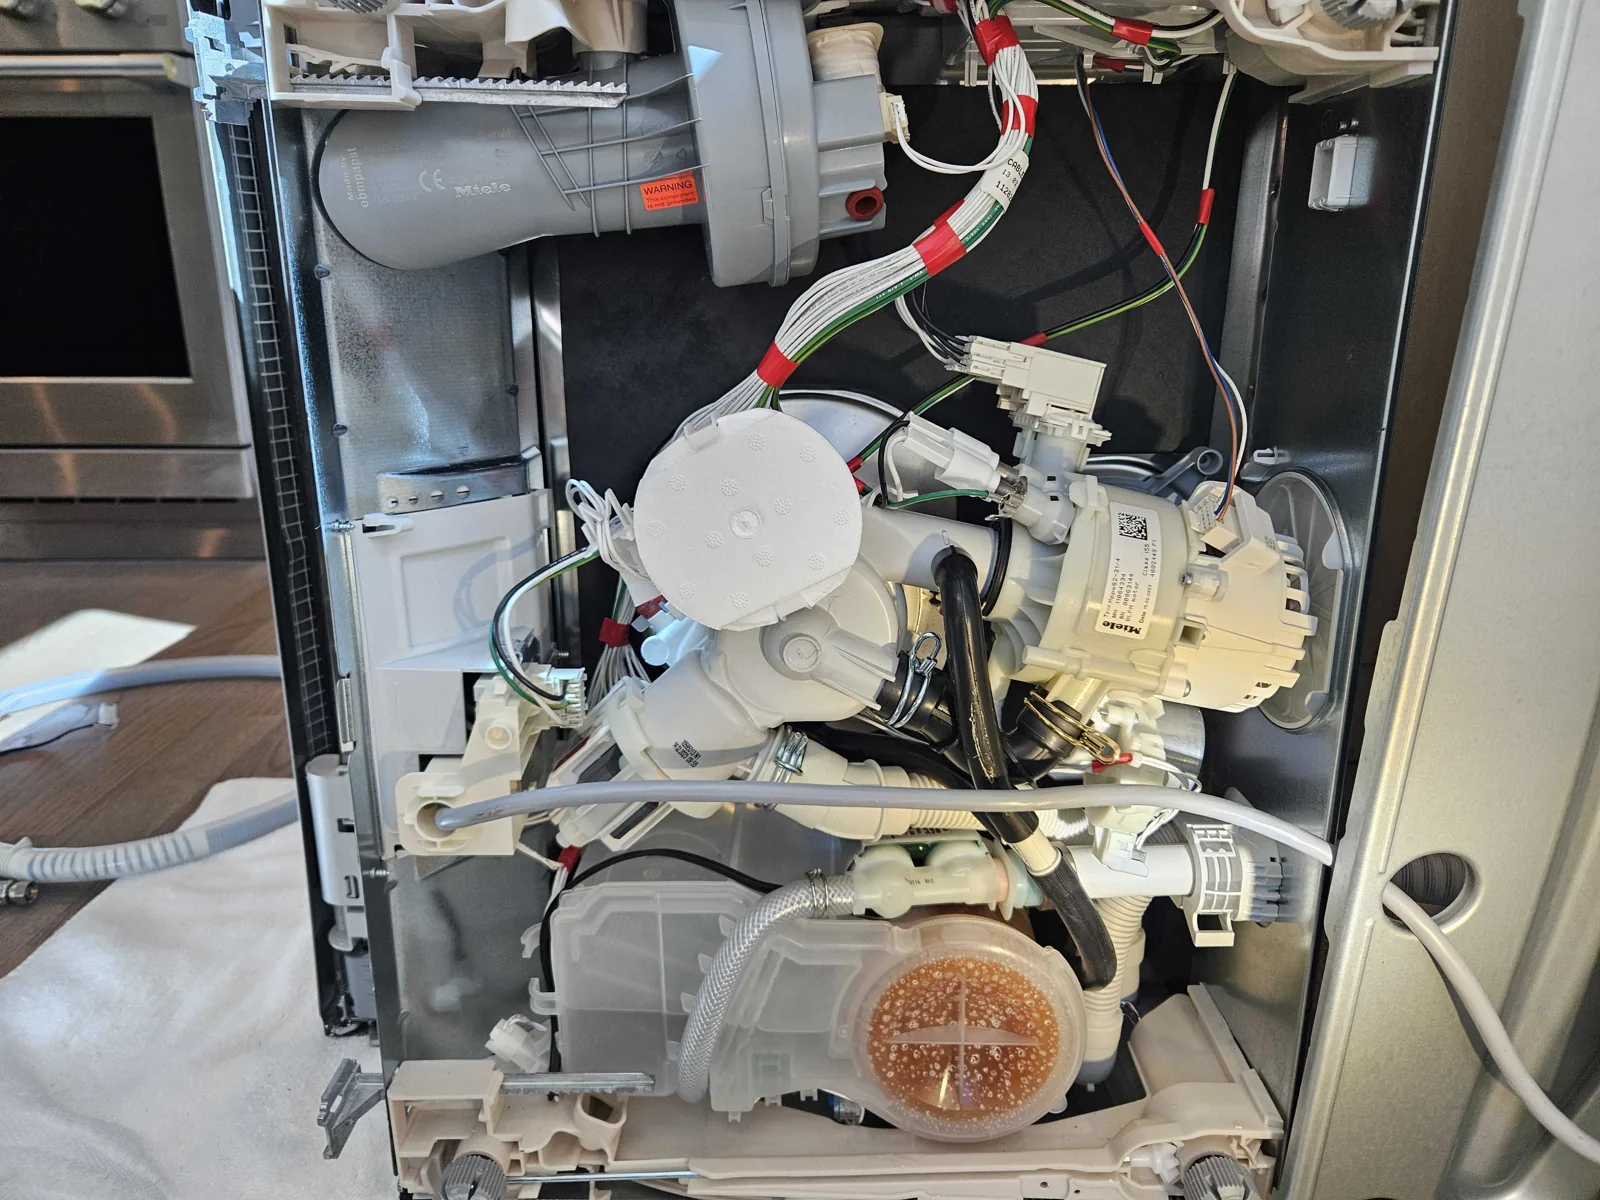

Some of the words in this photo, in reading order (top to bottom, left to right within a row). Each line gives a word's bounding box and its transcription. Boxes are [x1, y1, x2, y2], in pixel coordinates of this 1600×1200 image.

[346, 147, 369, 208] ebmpapst
[419, 168, 446, 193] CE
[454, 182, 511, 198] Miele
[643, 180, 693, 195] WARNING
[660, 191, 695, 201] component
[666, 196, 697, 206] grounded
[1138, 611, 1147, 624] Date
[1102, 620, 1142, 635] Miele
